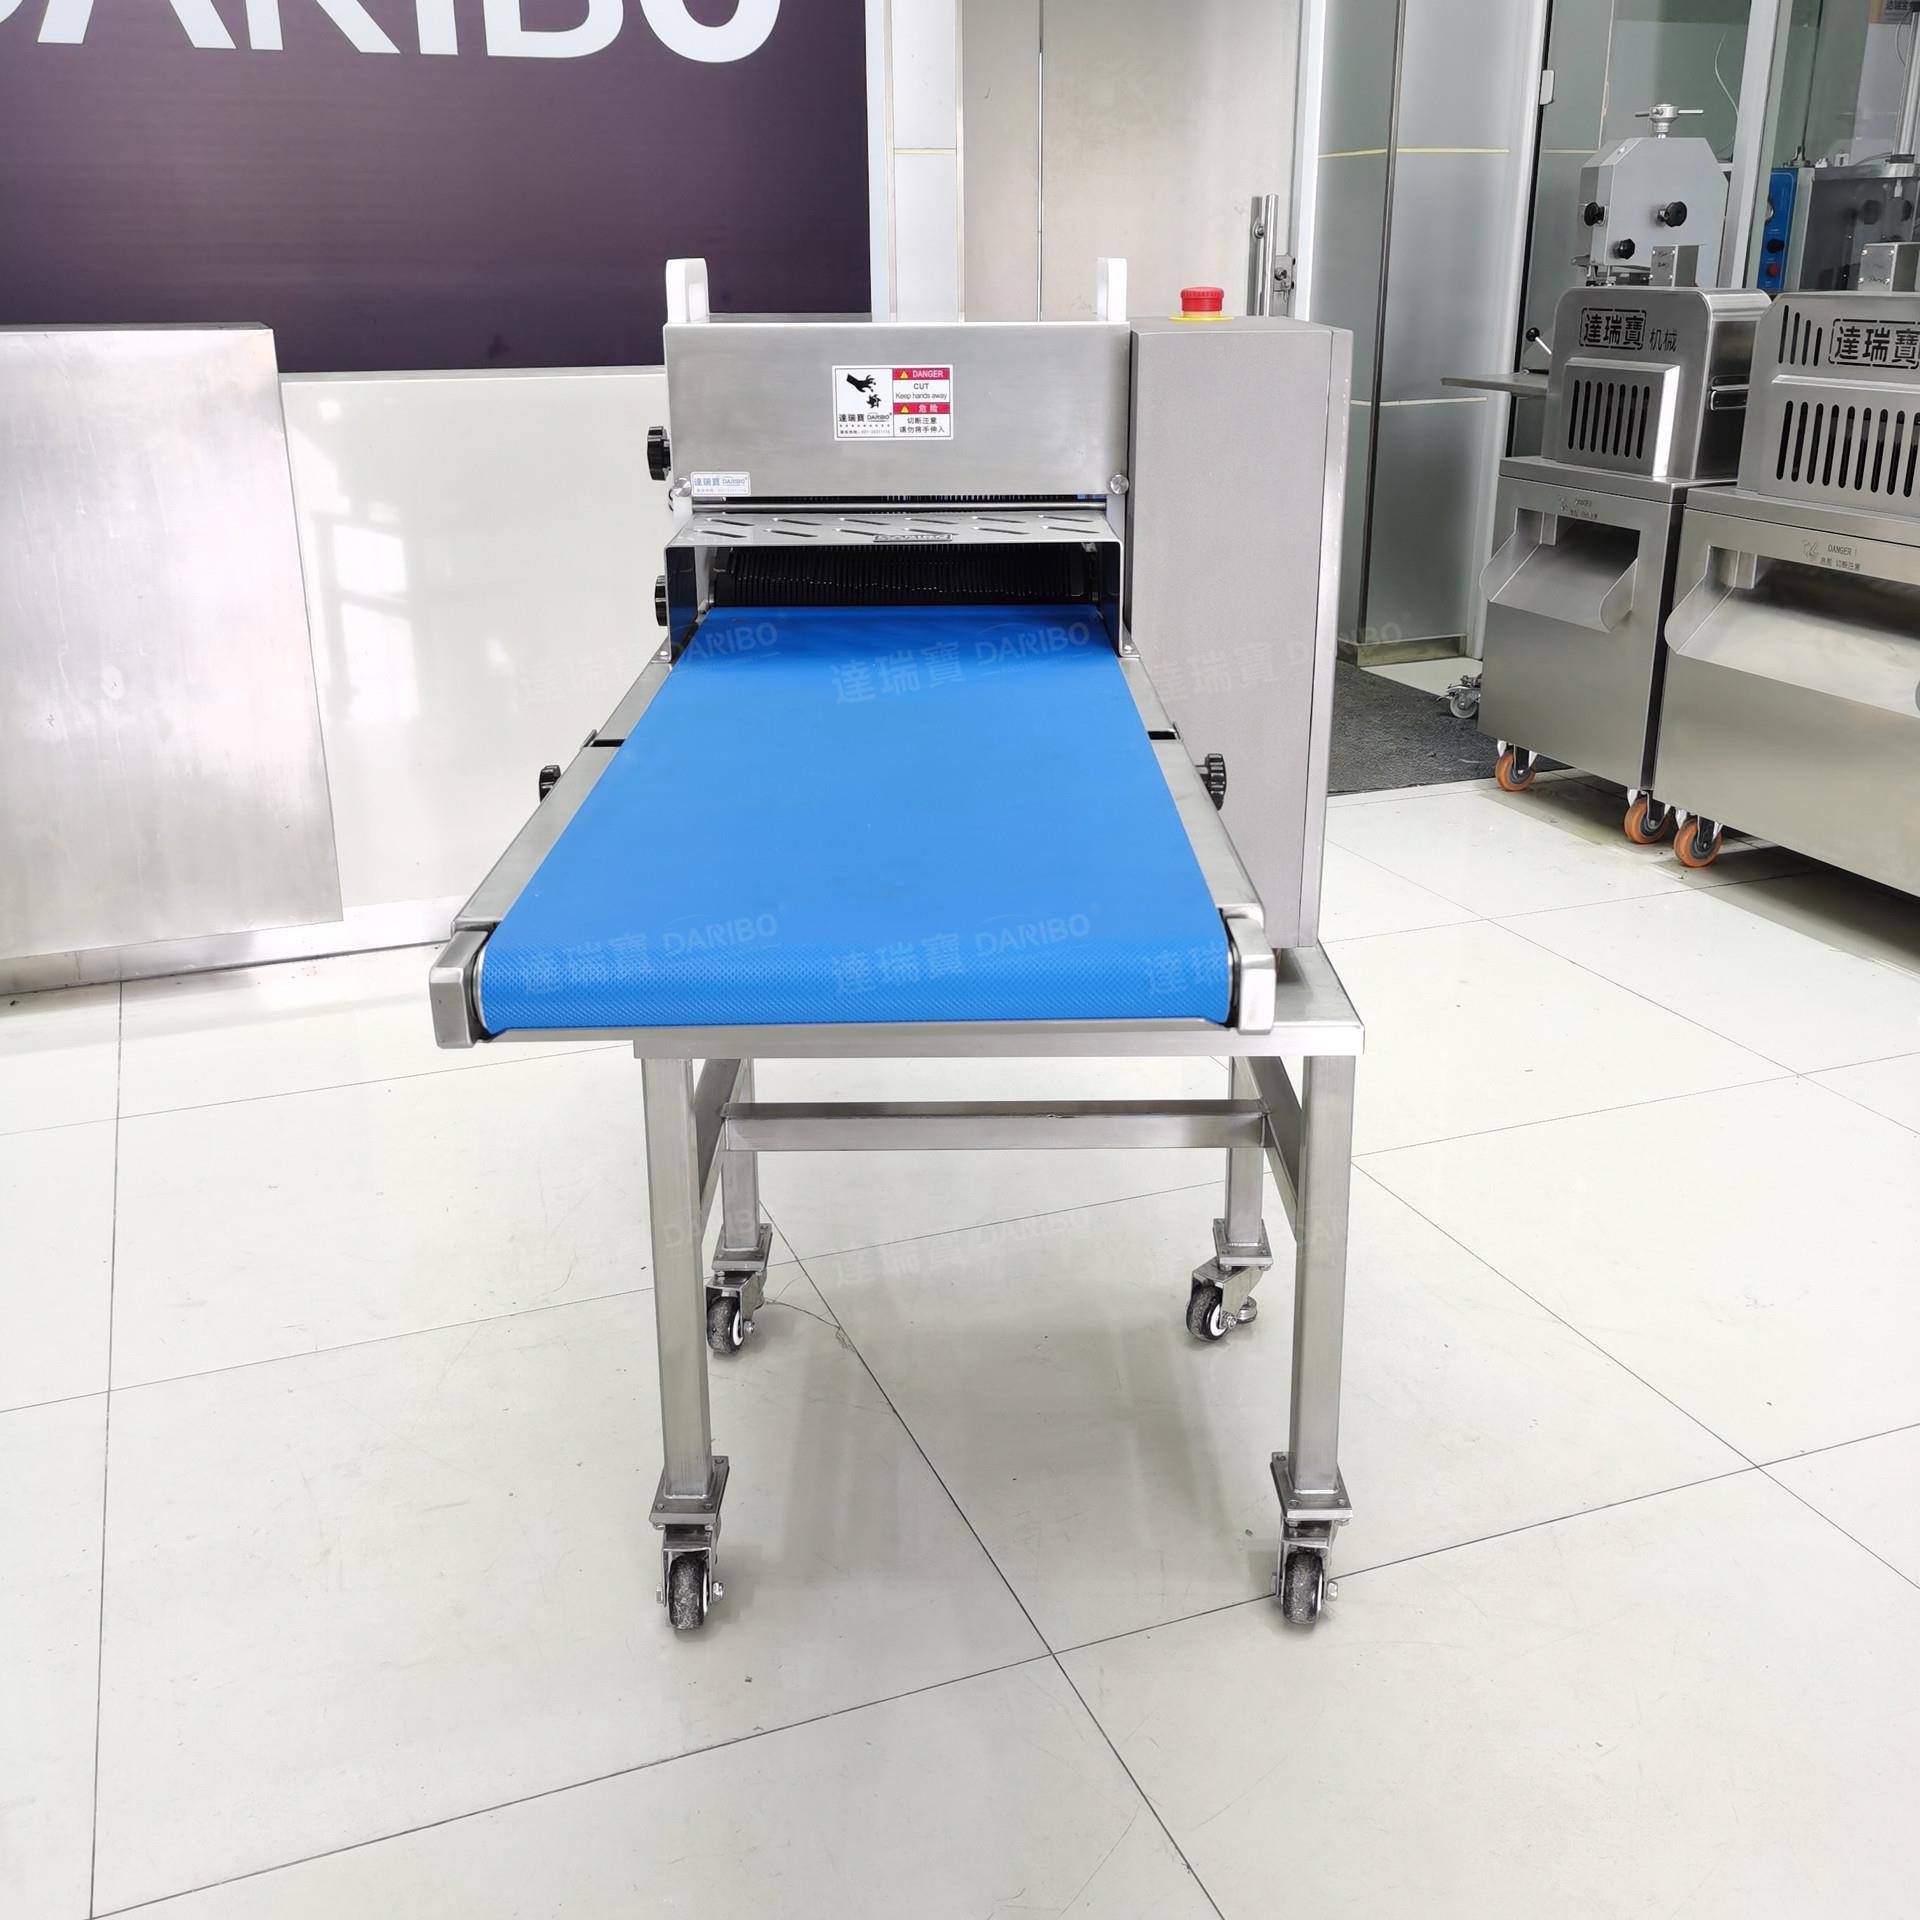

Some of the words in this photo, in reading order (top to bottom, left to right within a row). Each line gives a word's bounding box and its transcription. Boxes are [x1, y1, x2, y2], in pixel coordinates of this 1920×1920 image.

[1584, 314, 1644, 346] 達瑞寶
[1650, 328, 1678, 352] 机械
[1834, 326, 1920, 365] 達瑞寶
[912, 370, 944, 378] DANGER
